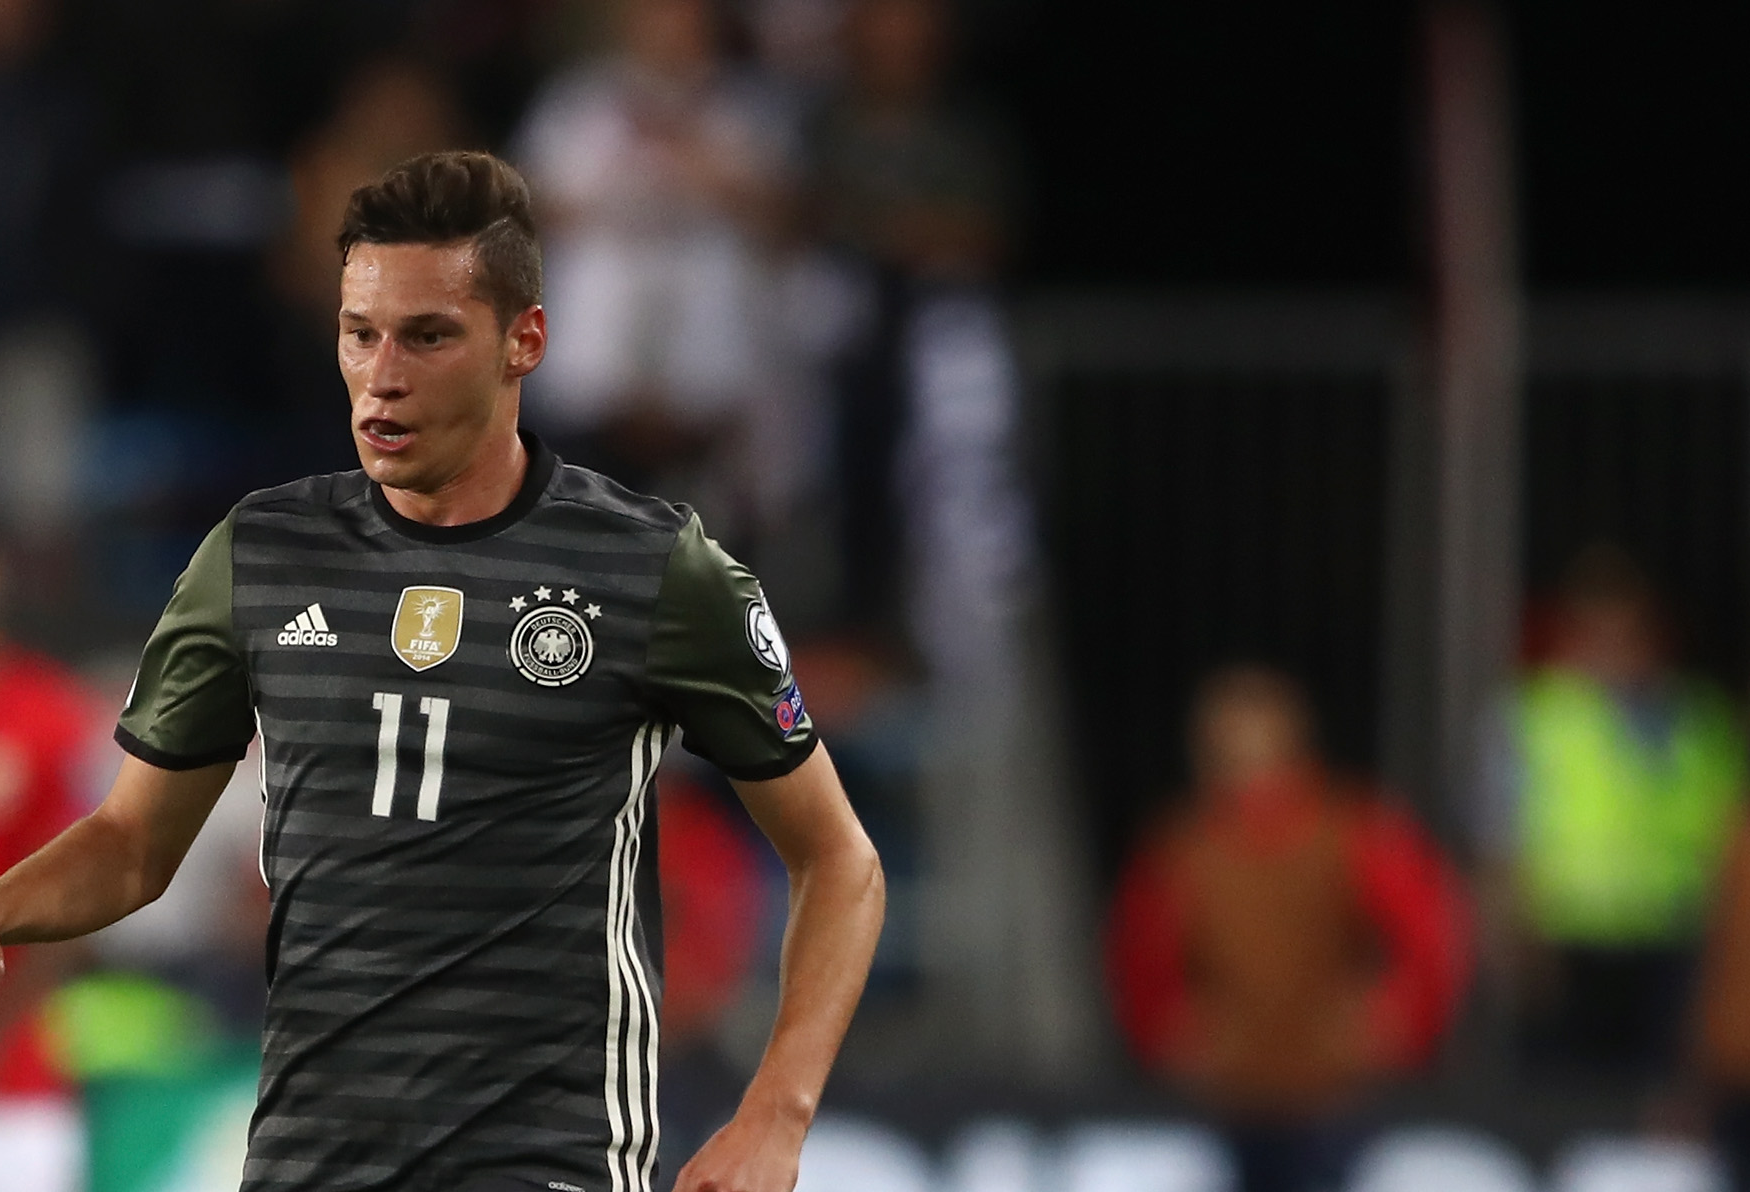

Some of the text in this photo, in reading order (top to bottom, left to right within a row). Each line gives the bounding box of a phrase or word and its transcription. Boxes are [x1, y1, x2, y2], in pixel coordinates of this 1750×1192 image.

[530, 617, 577, 635] DEUTSCHER
[277, 629, 338, 647] adidas
[410, 639, 439, 652] FIFA
[371, 692, 451, 822] 11
